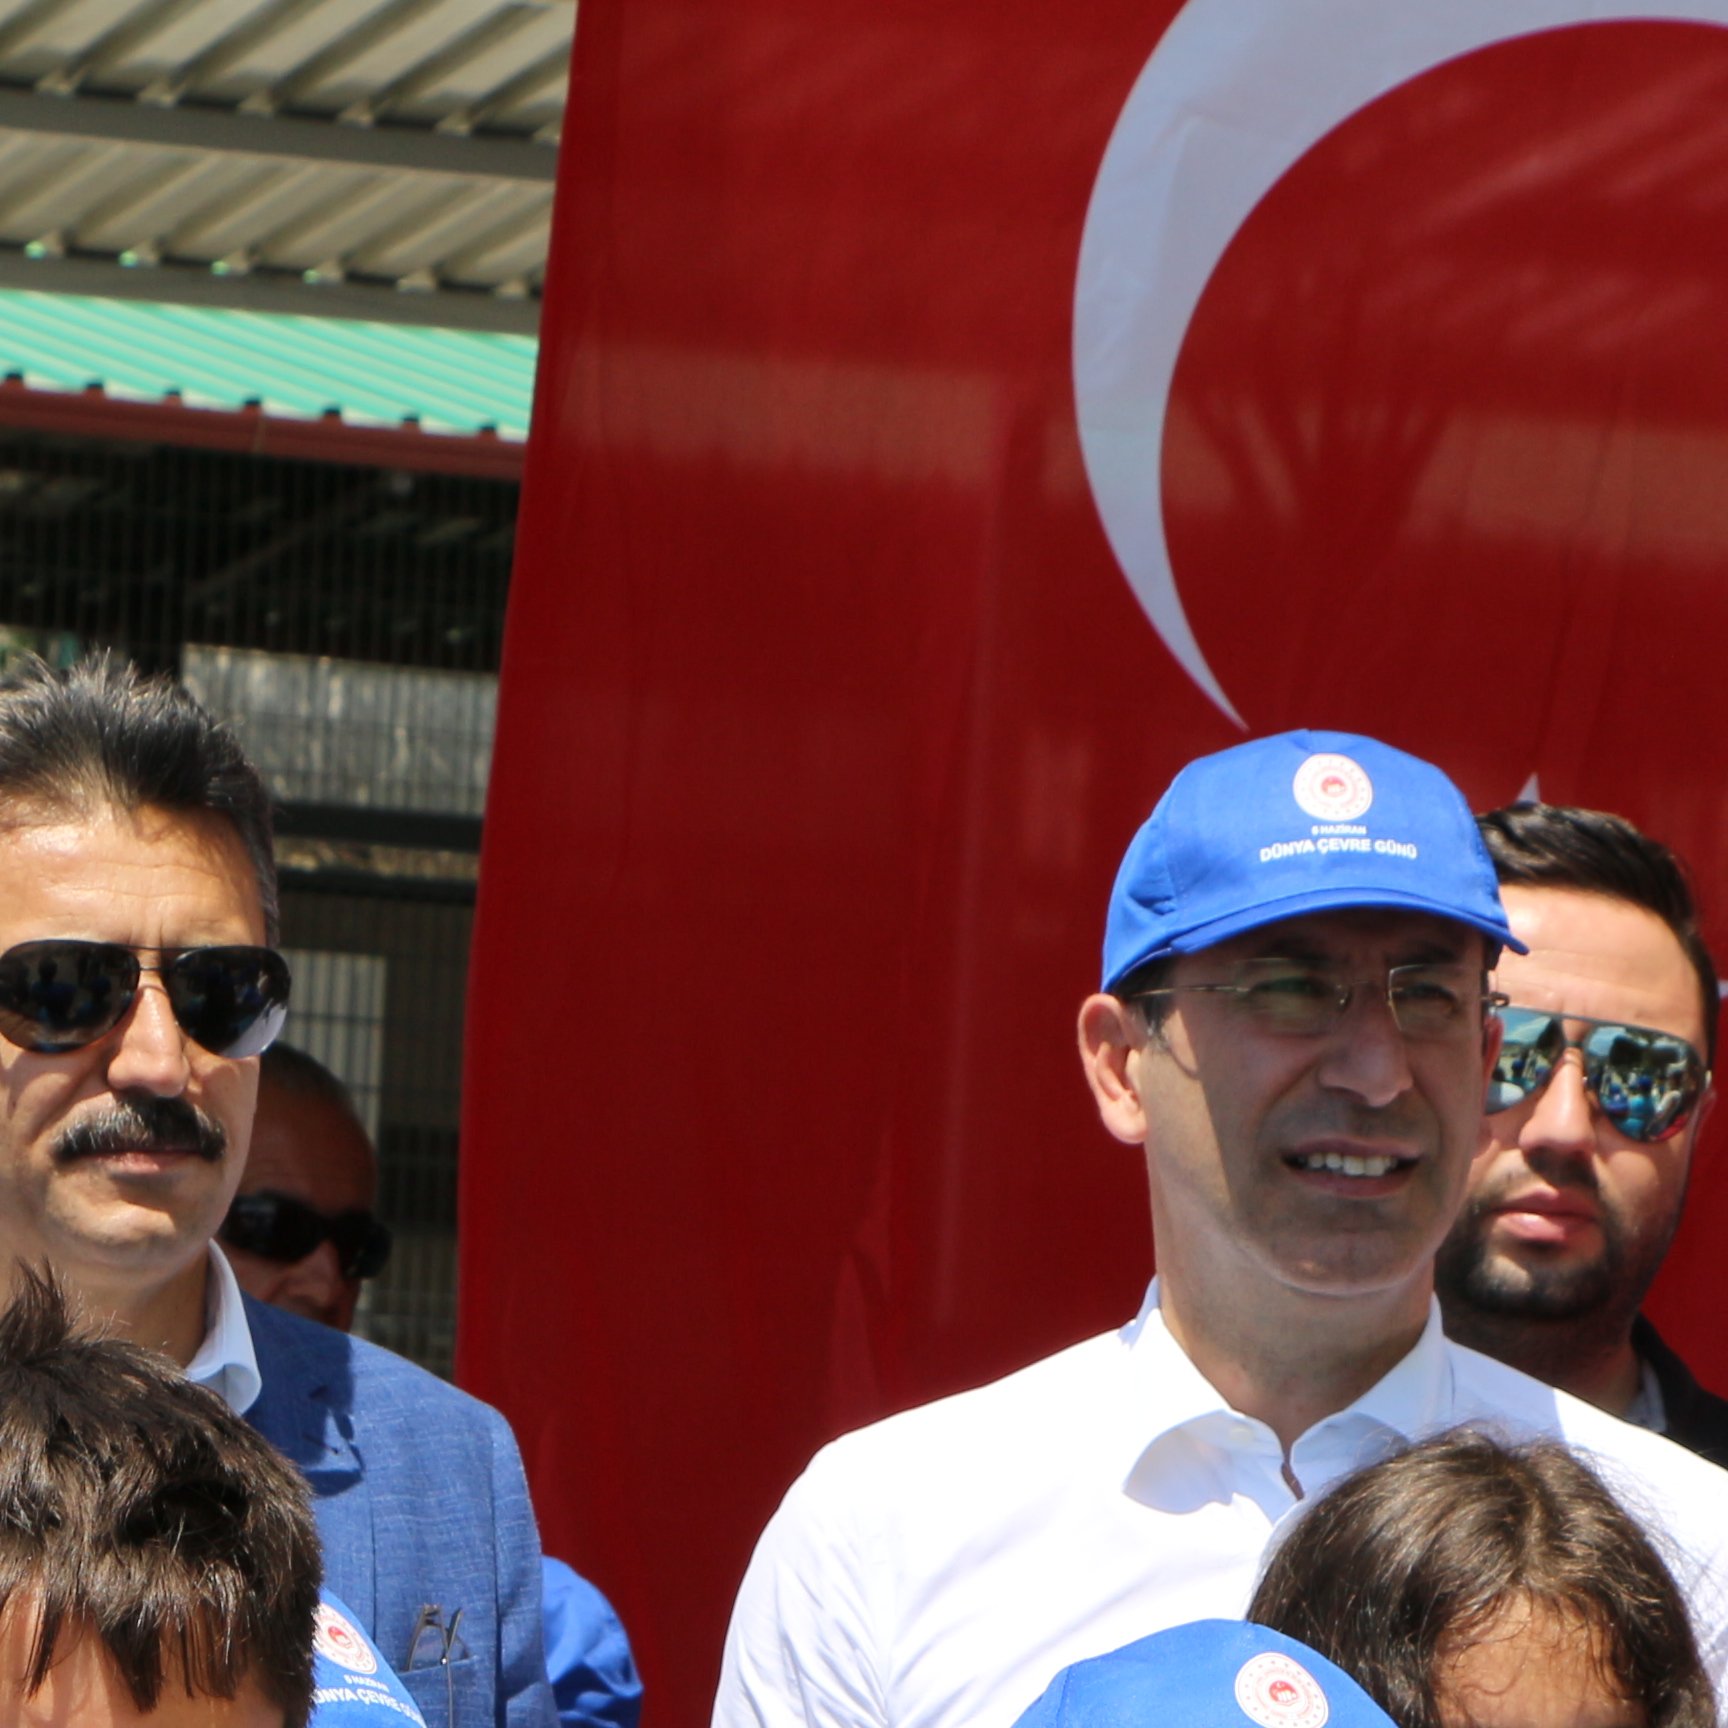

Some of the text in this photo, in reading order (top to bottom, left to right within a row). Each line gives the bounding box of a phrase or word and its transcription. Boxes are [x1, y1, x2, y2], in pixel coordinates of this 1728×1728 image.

[1260, 838, 1418, 862] DÜNYA ÇEVRE GÜNÜ
